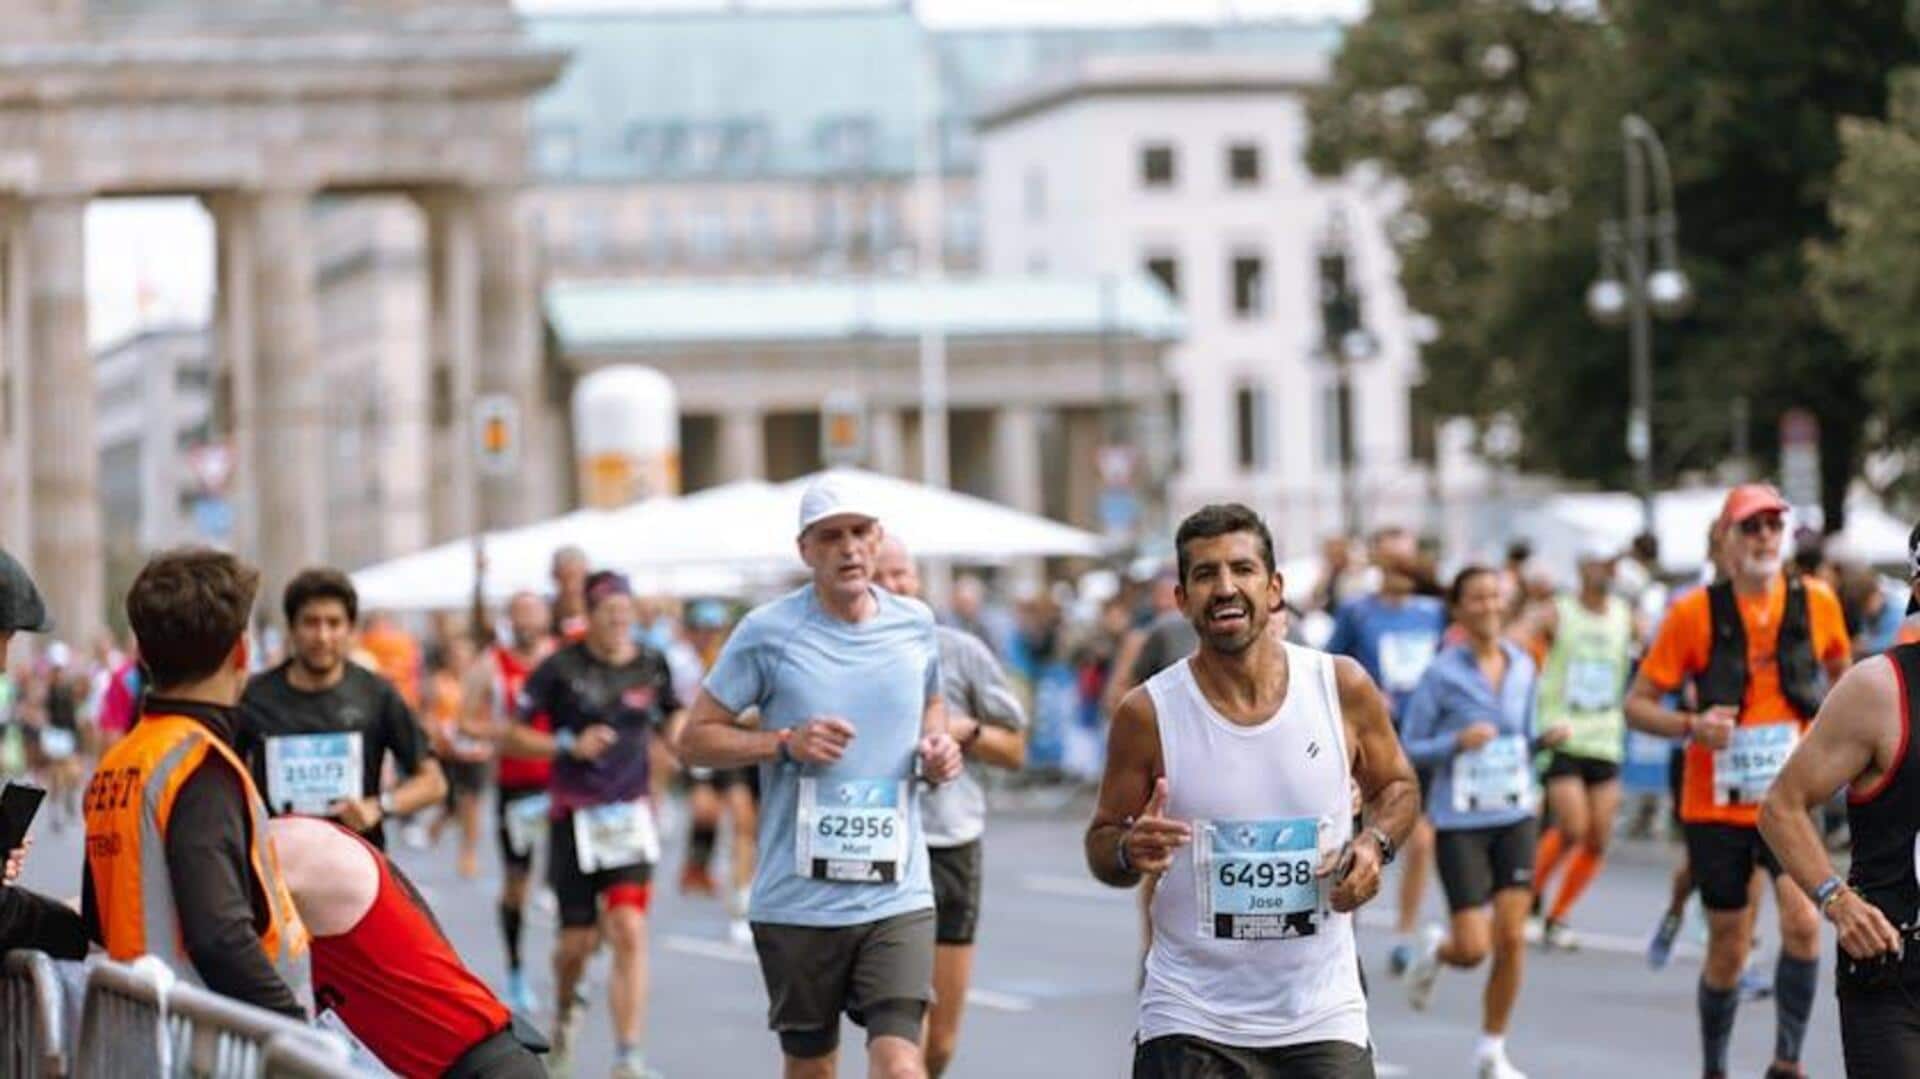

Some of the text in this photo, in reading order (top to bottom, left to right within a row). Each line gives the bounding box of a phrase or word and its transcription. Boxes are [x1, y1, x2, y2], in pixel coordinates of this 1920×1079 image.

[818, 815, 893, 838] 62956
[1219, 861, 1311, 887] 64938
[1249, 895, 1283, 909] Jose
